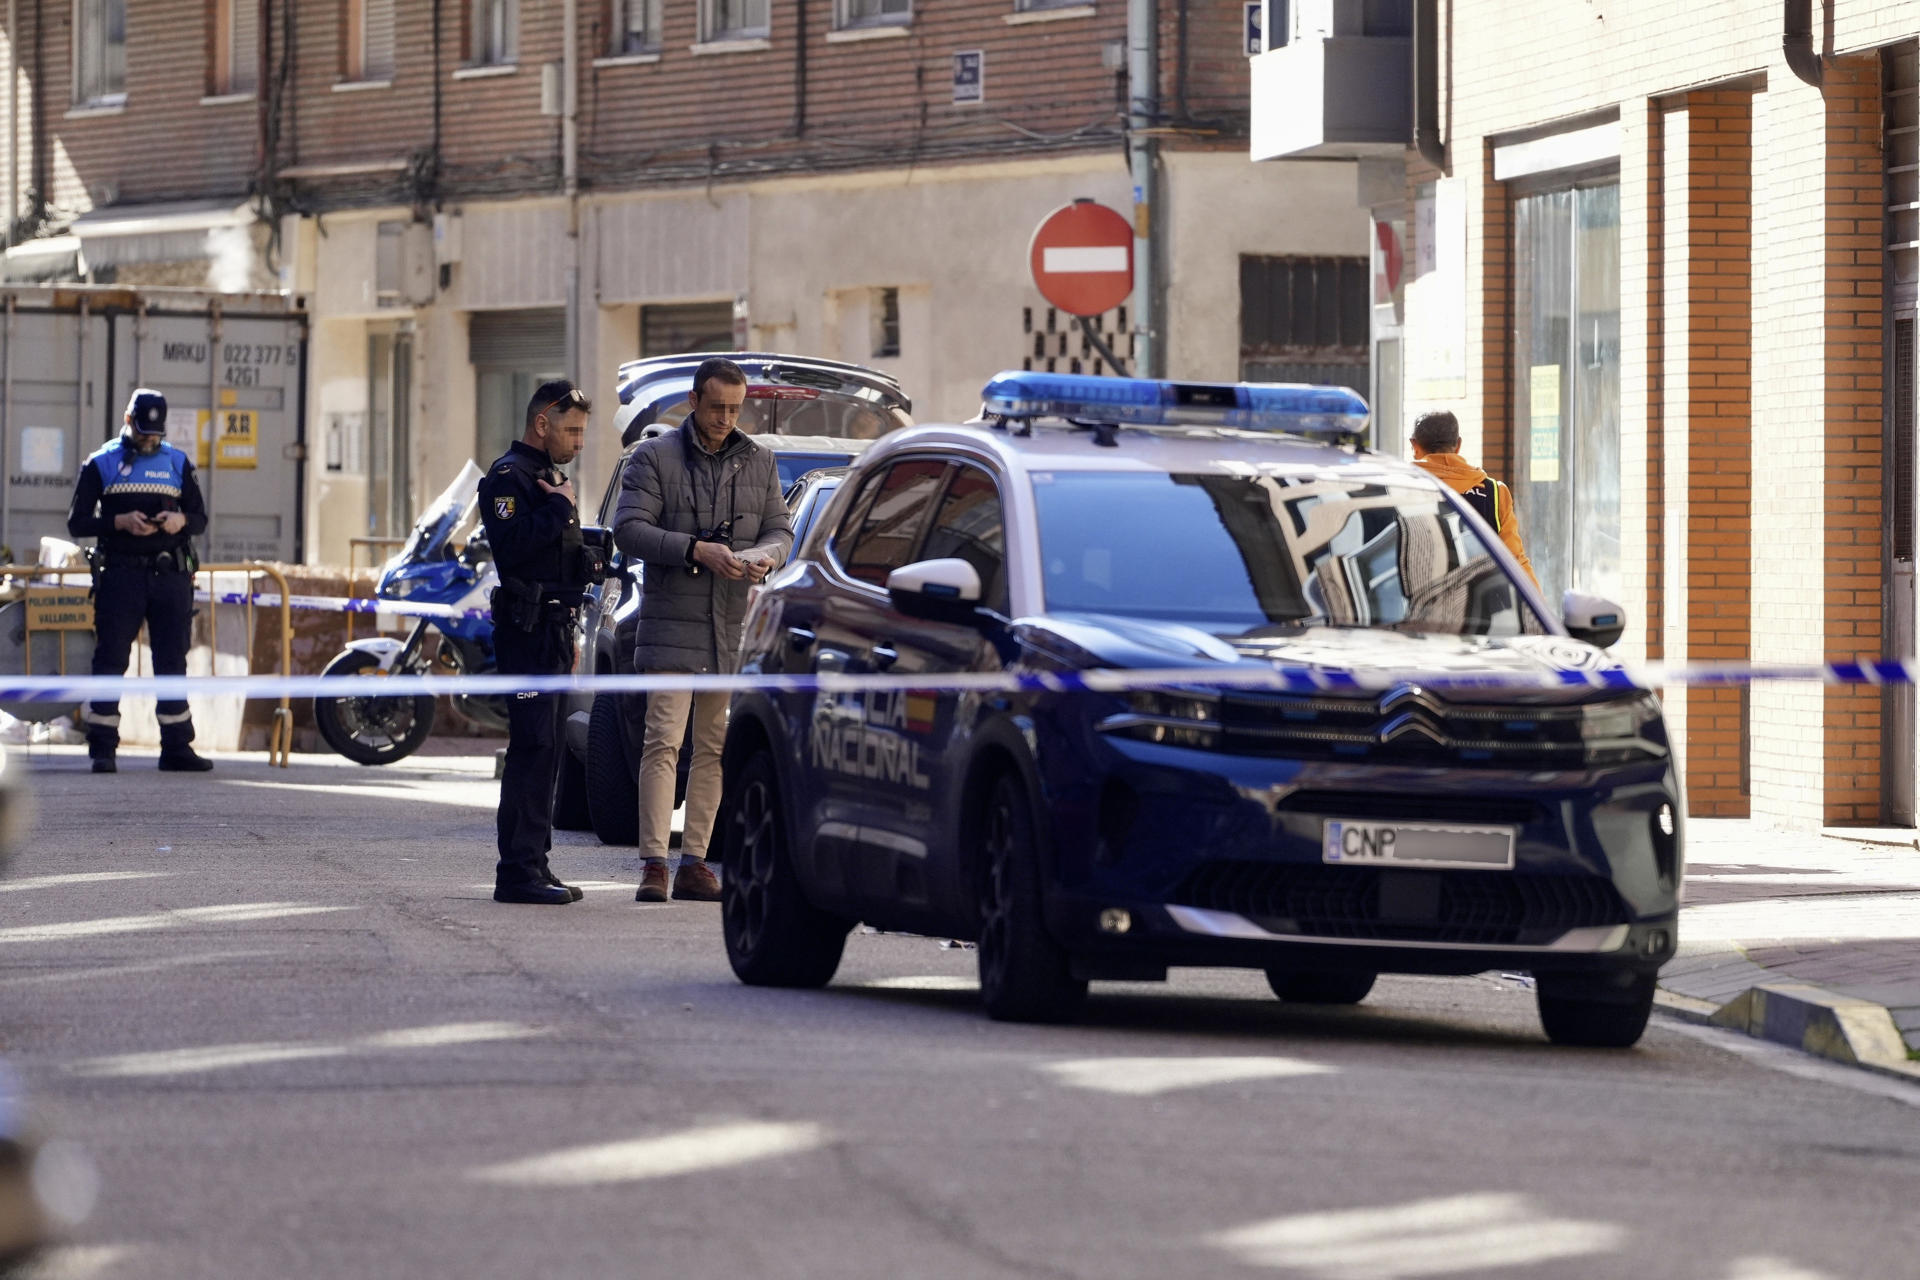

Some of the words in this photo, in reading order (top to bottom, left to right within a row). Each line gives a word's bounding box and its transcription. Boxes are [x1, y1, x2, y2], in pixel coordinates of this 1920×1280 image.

[162, 343, 206, 363] MRKU
[223, 344, 250, 364] 022
[254, 345, 281, 364] 377
[285, 345, 297, 365] 5
[9, 475, 73, 488] MAERSK
[517, 691, 538, 699] CNP
[812, 724, 930, 789] NACIONAL
